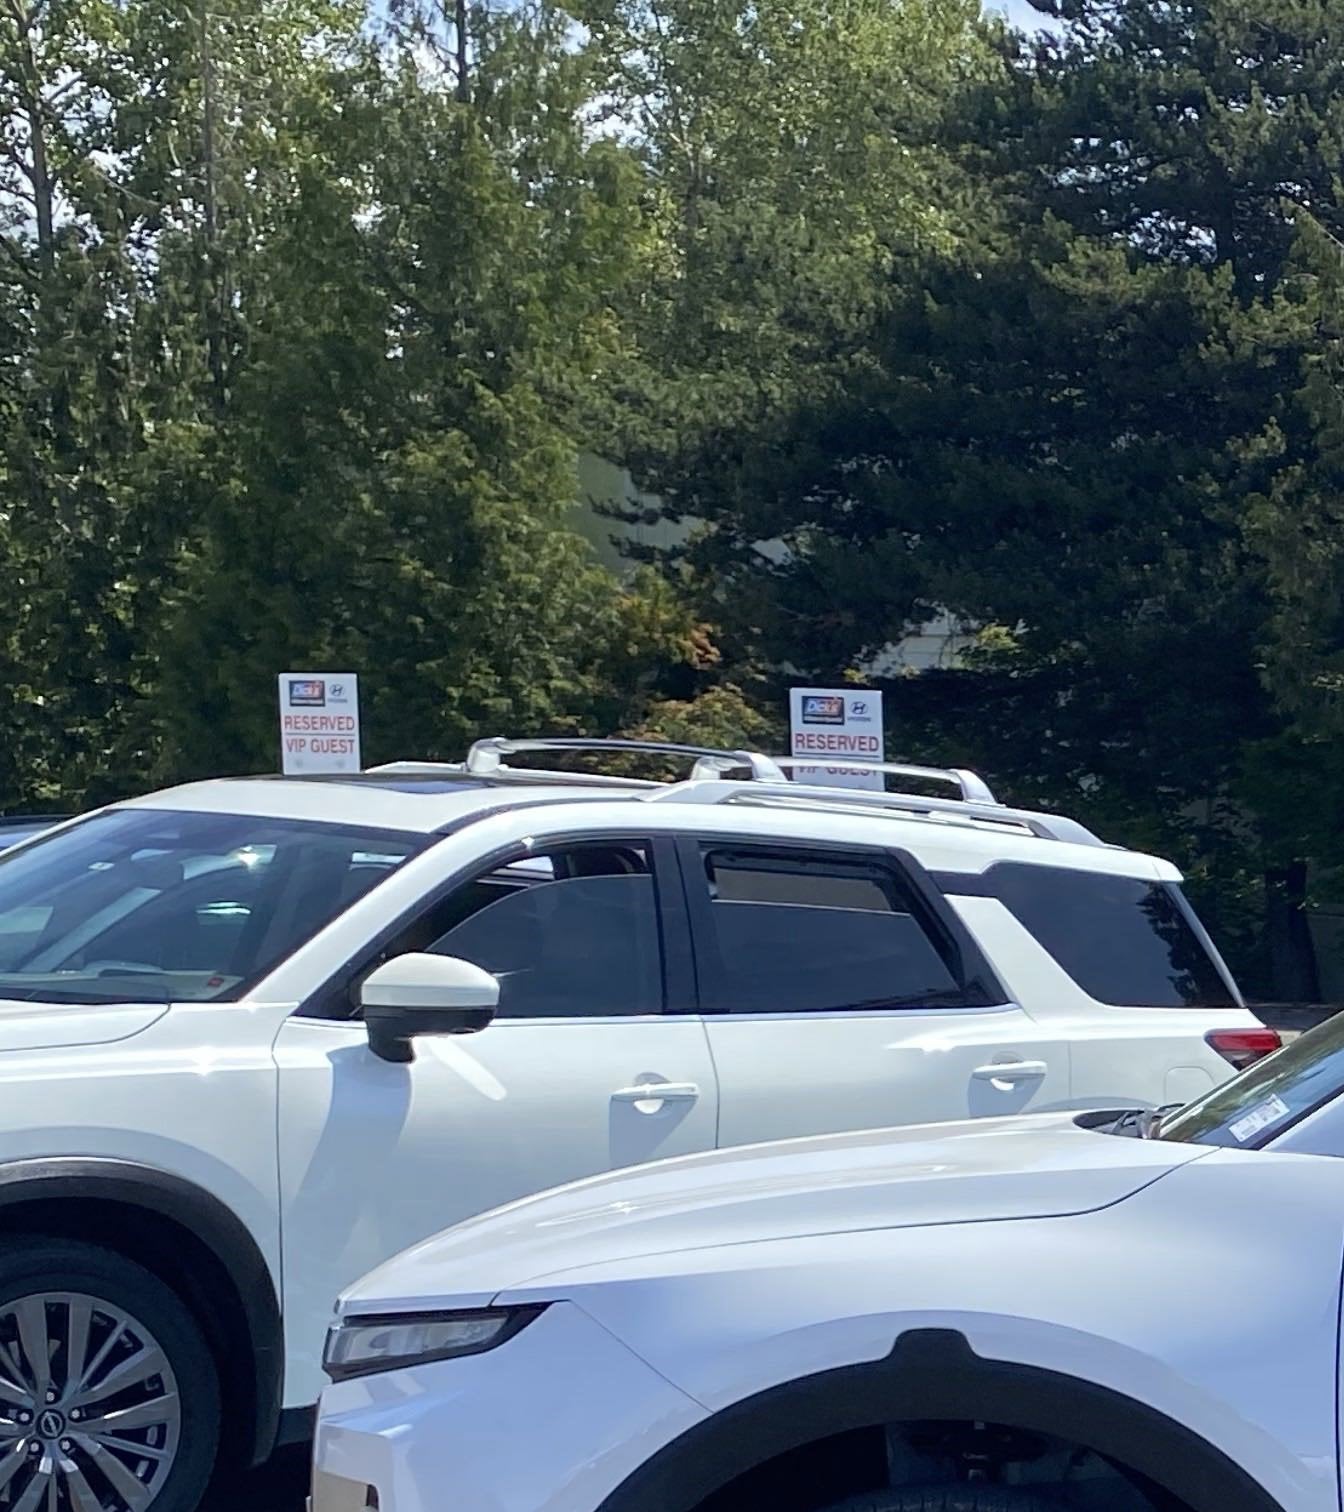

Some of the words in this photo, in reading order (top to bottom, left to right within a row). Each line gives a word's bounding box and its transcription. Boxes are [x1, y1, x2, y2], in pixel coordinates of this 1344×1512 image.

[284, 715, 355, 731] RESERVED
[286, 738, 306, 753] VIP
[310, 738, 355, 754] GUEST
[794, 733, 880, 752] RESERVED
